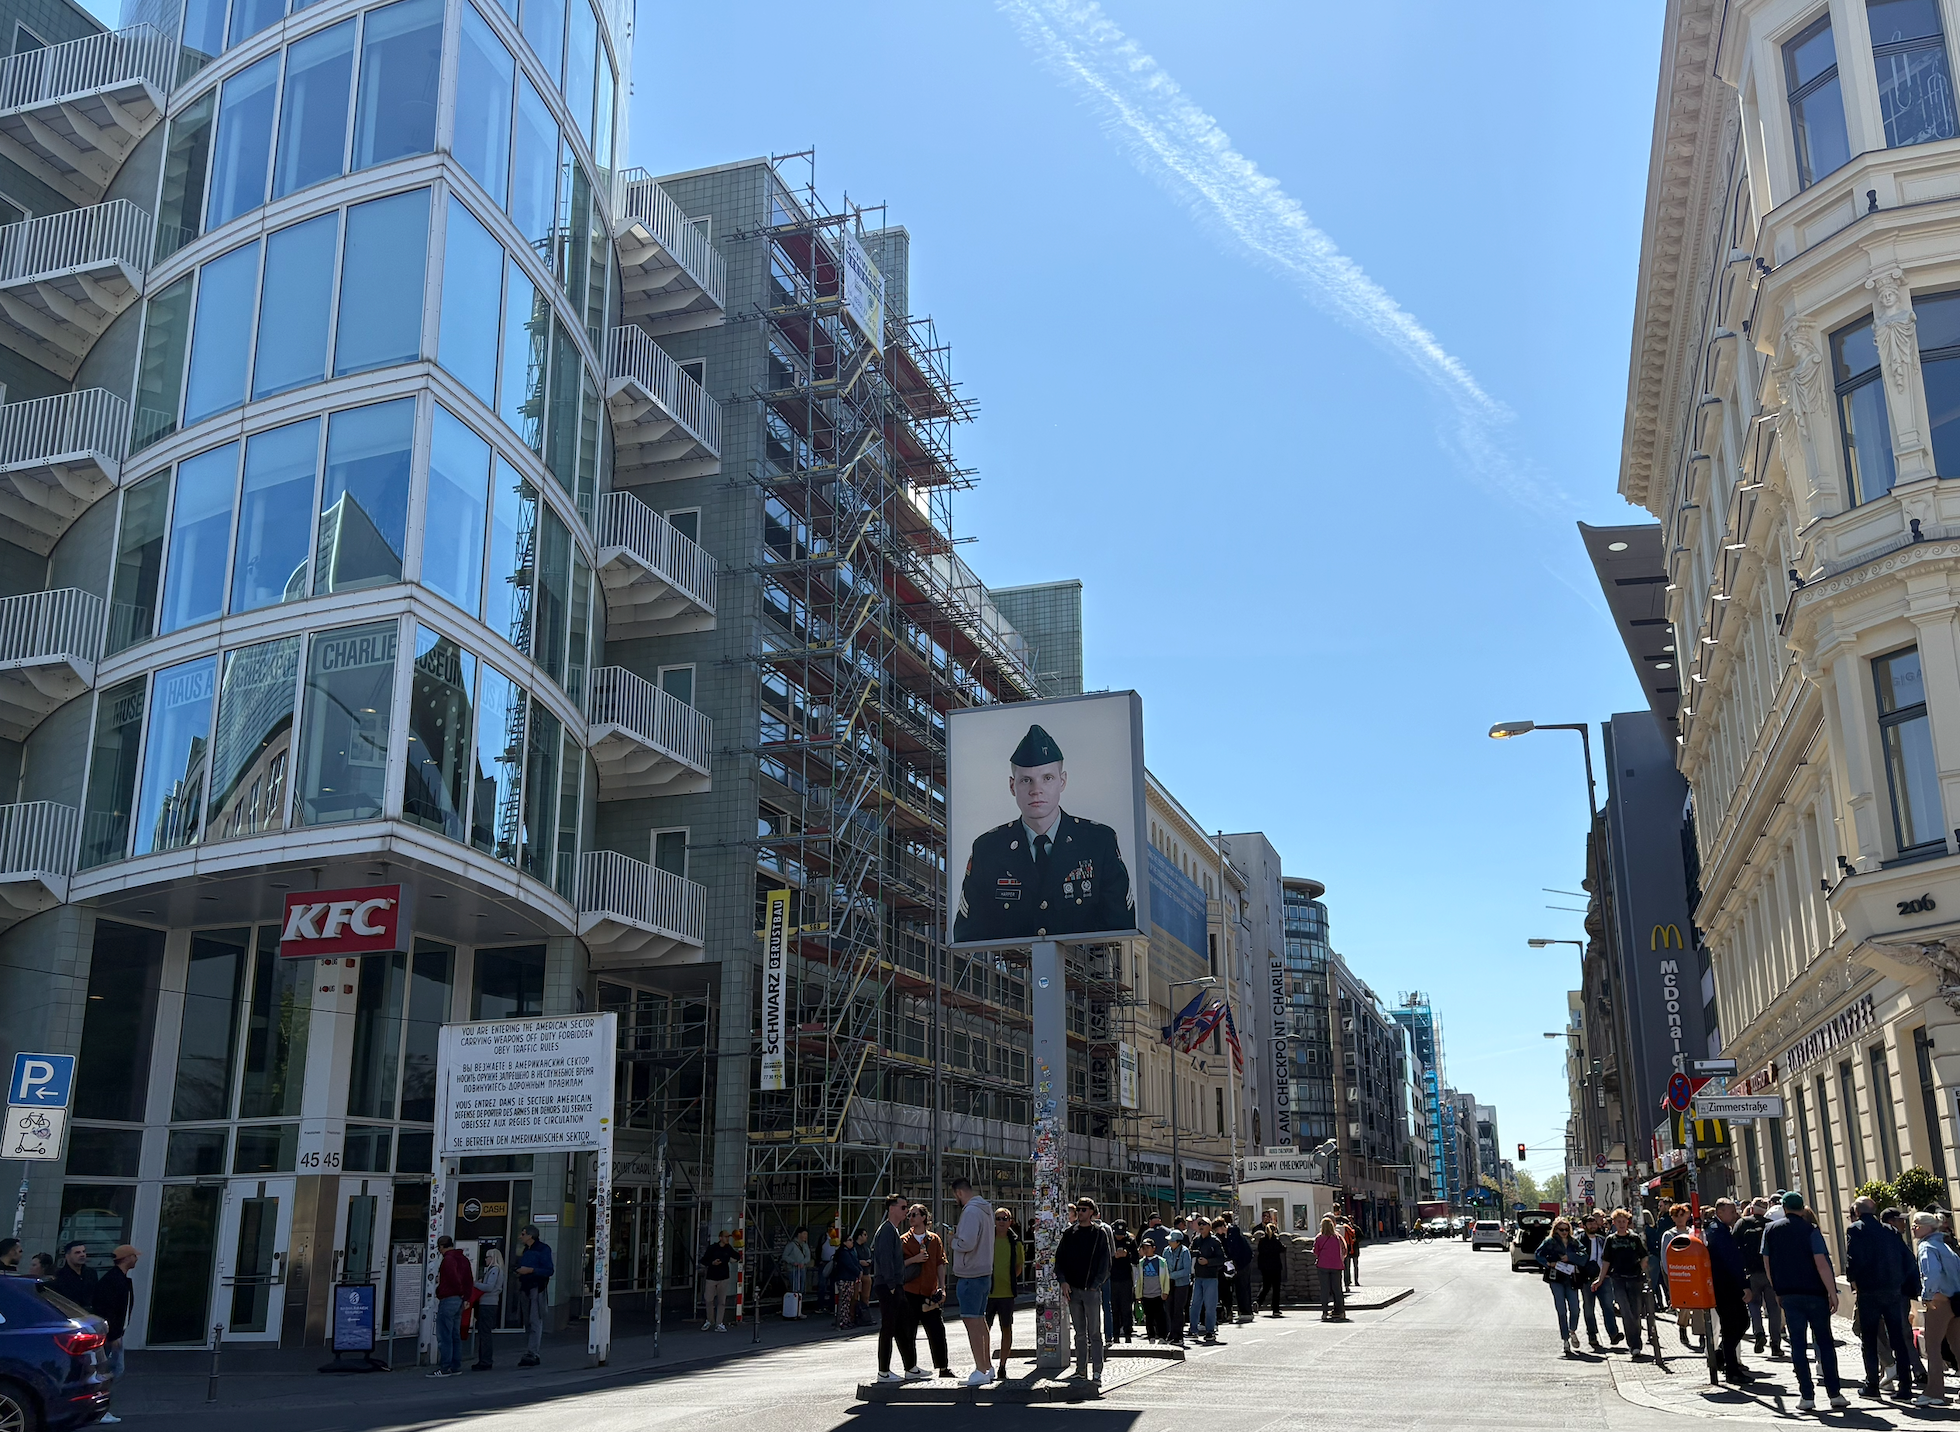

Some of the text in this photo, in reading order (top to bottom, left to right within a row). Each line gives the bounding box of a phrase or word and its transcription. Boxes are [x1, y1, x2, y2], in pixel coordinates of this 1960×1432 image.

[323, 633, 397, 670] CHARLIE
[415, 641, 464, 690] USEUM
[167, 675, 201, 705] HAUS
[1897, 893, 1936, 916] 206
[280, 898, 390, 941] KFC
[1272, 961, 1284, 1016] CHARLIE
[768, 973, 779, 1054] SCHWARZ
[462, 1018, 595, 1036] YOU ARE ENTERING THE AMERICAN SECTOR
[1786, 994, 1874, 1073] EINSTEIN KAFFEE
[461, 1029, 593, 1046] CARRYING WEAPONS OFF DUTY FORBIDDEN
[494, 1042, 559, 1055] OBEY TRAFFIC RULES
[462, 1063, 473, 1072] ВЫ
[508, 1061, 513, 1070] В
[566, 1056, 590, 1066] СЕКТОР
[576, 1066, 594, 1076] ВРЕМЯ
[1274, 1020, 1289, 1106] CHECKPONT
[19, 1060, 54, 1099] P
[455, 1100, 471, 1109] VOUS
[475, 1098, 496, 1108] ENTREZ
[499, 1097, 515, 1106] DANS
[518, 1097, 524, 1105] LE
[527, 1095, 554, 1105] SECTEUR
[1708, 1101, 1768, 1113] Zimmerstraße
[454, 1103, 593, 1119] DEFENSE DE PORTER DES ARMES EN DEHORS DU SERVICE
[461, 1119, 490, 1129] OBEISSEZ
[493, 1118, 506, 1127] AUX
[533, 1116, 540, 1125] DE
[544, 1114, 583, 1125] CIRCULATION
[1279, 1110, 1290, 1133] AM
[453, 1131, 590, 1147] SIE BETRETEN DEN AMERIKANISCHEN SEKTOR
[301, 1152, 319, 1167] 45
[324, 1152, 339, 1167] 45
[593, 1161, 630, 1174] CPOINT
[1248, 1160, 1316, 1171] US ARMY CHECKPOINT
[483, 1205, 505, 1213] CASH
